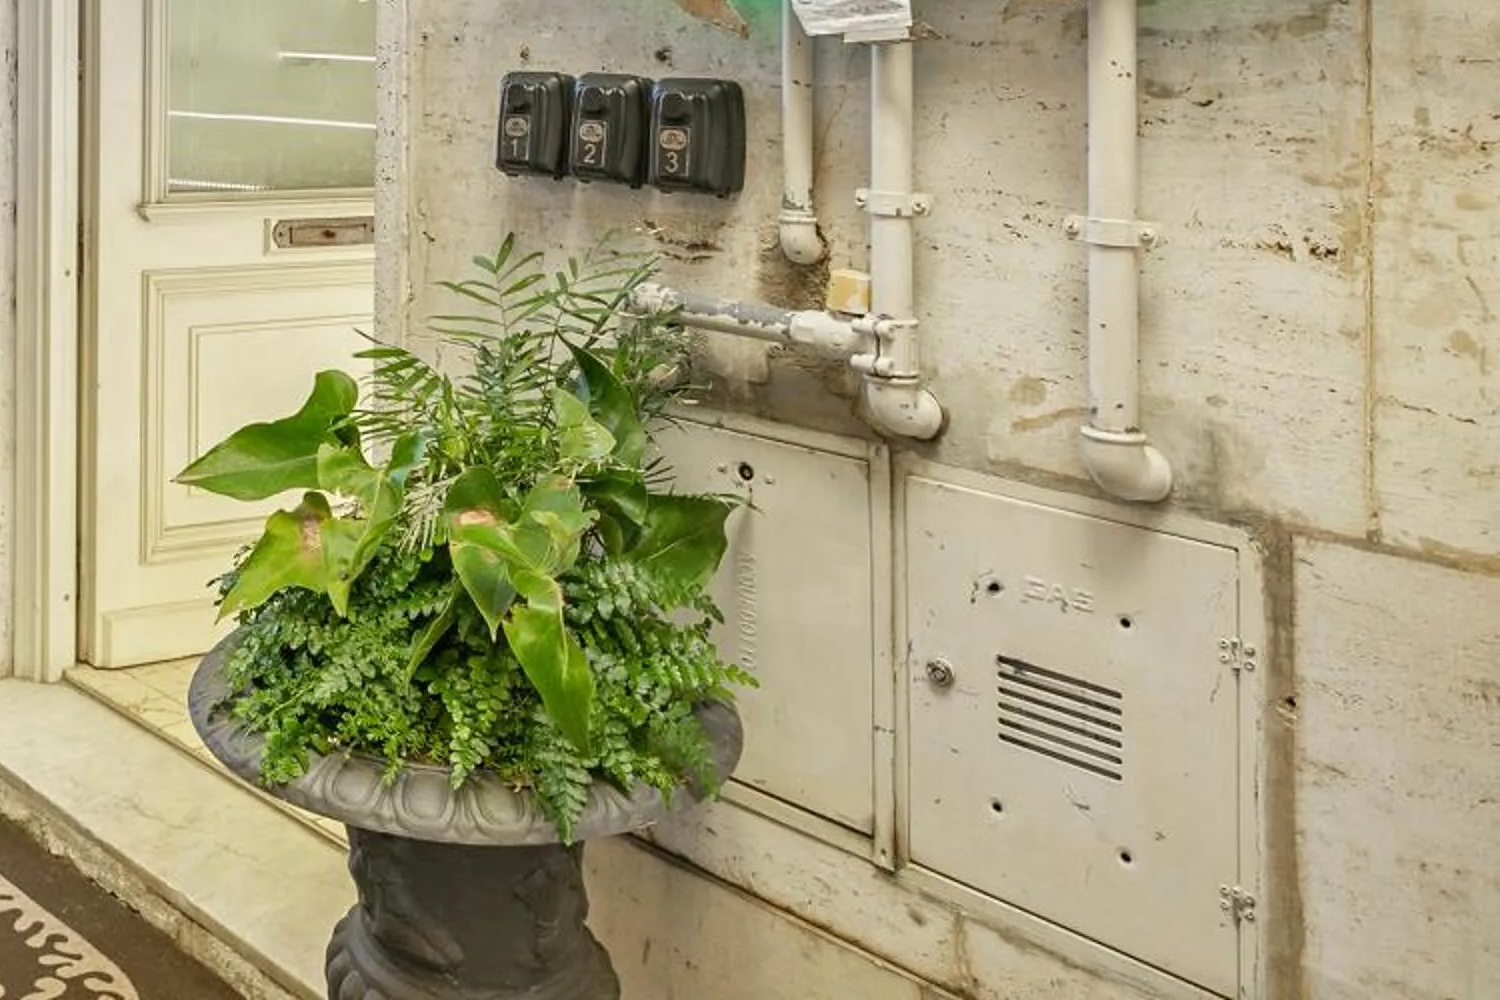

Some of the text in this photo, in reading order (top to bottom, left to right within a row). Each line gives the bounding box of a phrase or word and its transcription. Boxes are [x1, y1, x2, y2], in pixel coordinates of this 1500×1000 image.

[509, 138, 519, 157] 1
[583, 143, 597, 165] 2
[664, 151, 680, 174] 3
